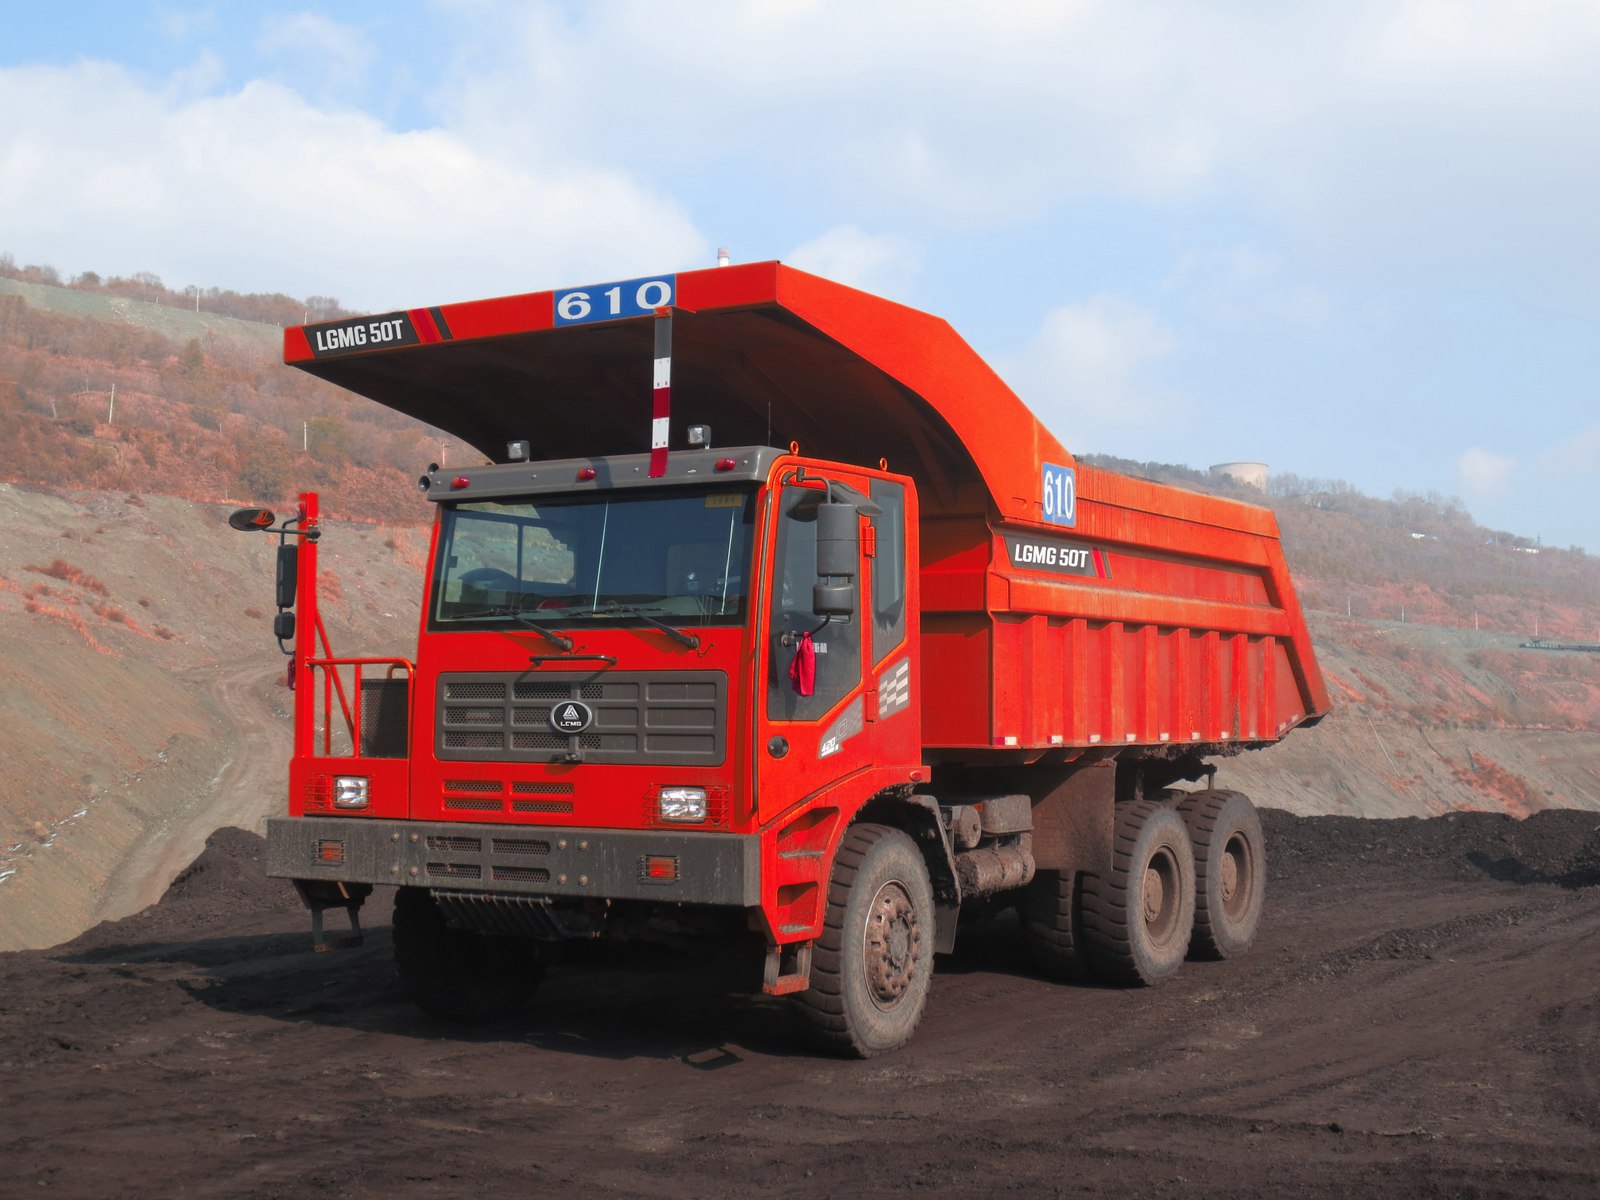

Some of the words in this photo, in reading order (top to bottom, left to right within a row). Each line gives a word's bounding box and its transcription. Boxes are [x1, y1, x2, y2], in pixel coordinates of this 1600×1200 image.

[557, 280, 672, 321] 610
[316, 324, 366, 352] LGMG
[370, 319, 404, 344] 50T
[1044, 470, 1074, 520] 610
[1014, 543, 1057, 565] LGMG
[1059, 548, 1089, 568] 50T
